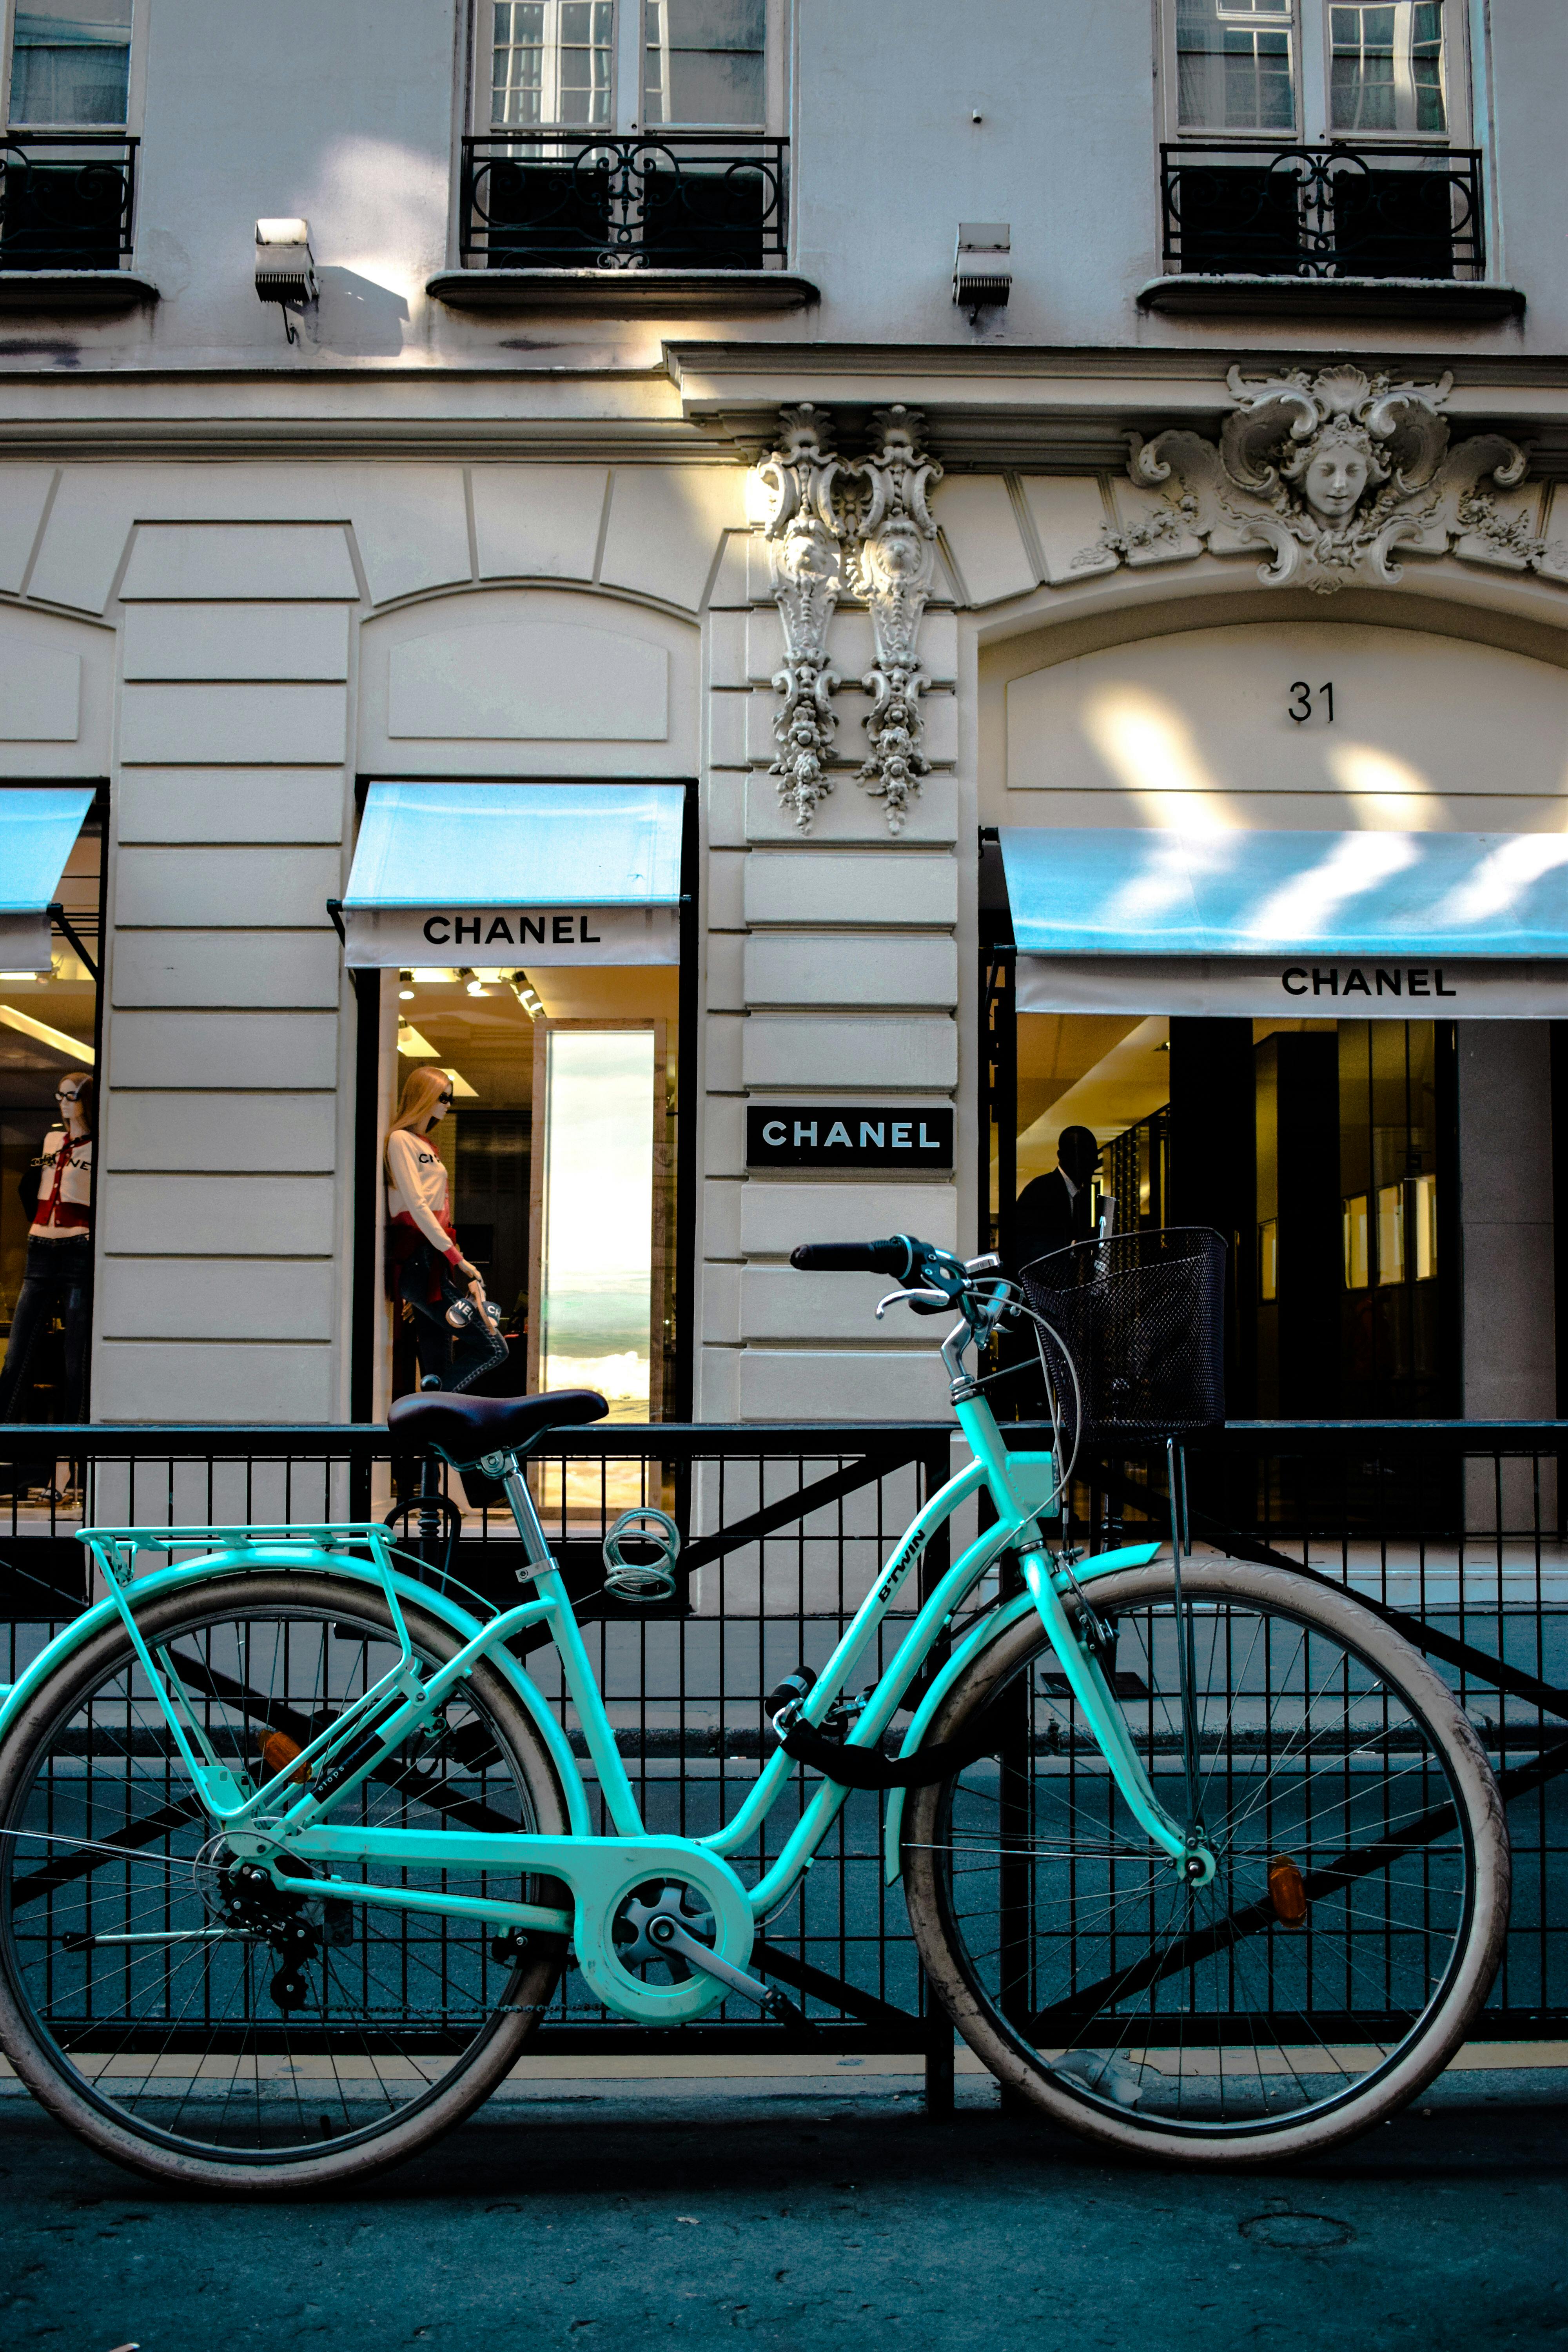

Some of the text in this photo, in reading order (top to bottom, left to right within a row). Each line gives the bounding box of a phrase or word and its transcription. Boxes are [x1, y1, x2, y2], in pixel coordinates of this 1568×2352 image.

[1289, 681, 1334, 722] 31
[423, 916, 601, 944] CHANEL
[1282, 967, 1456, 996] CHANEL
[762, 1121, 940, 1148] CHANEL
[318, 1766, 344, 1791] elops
